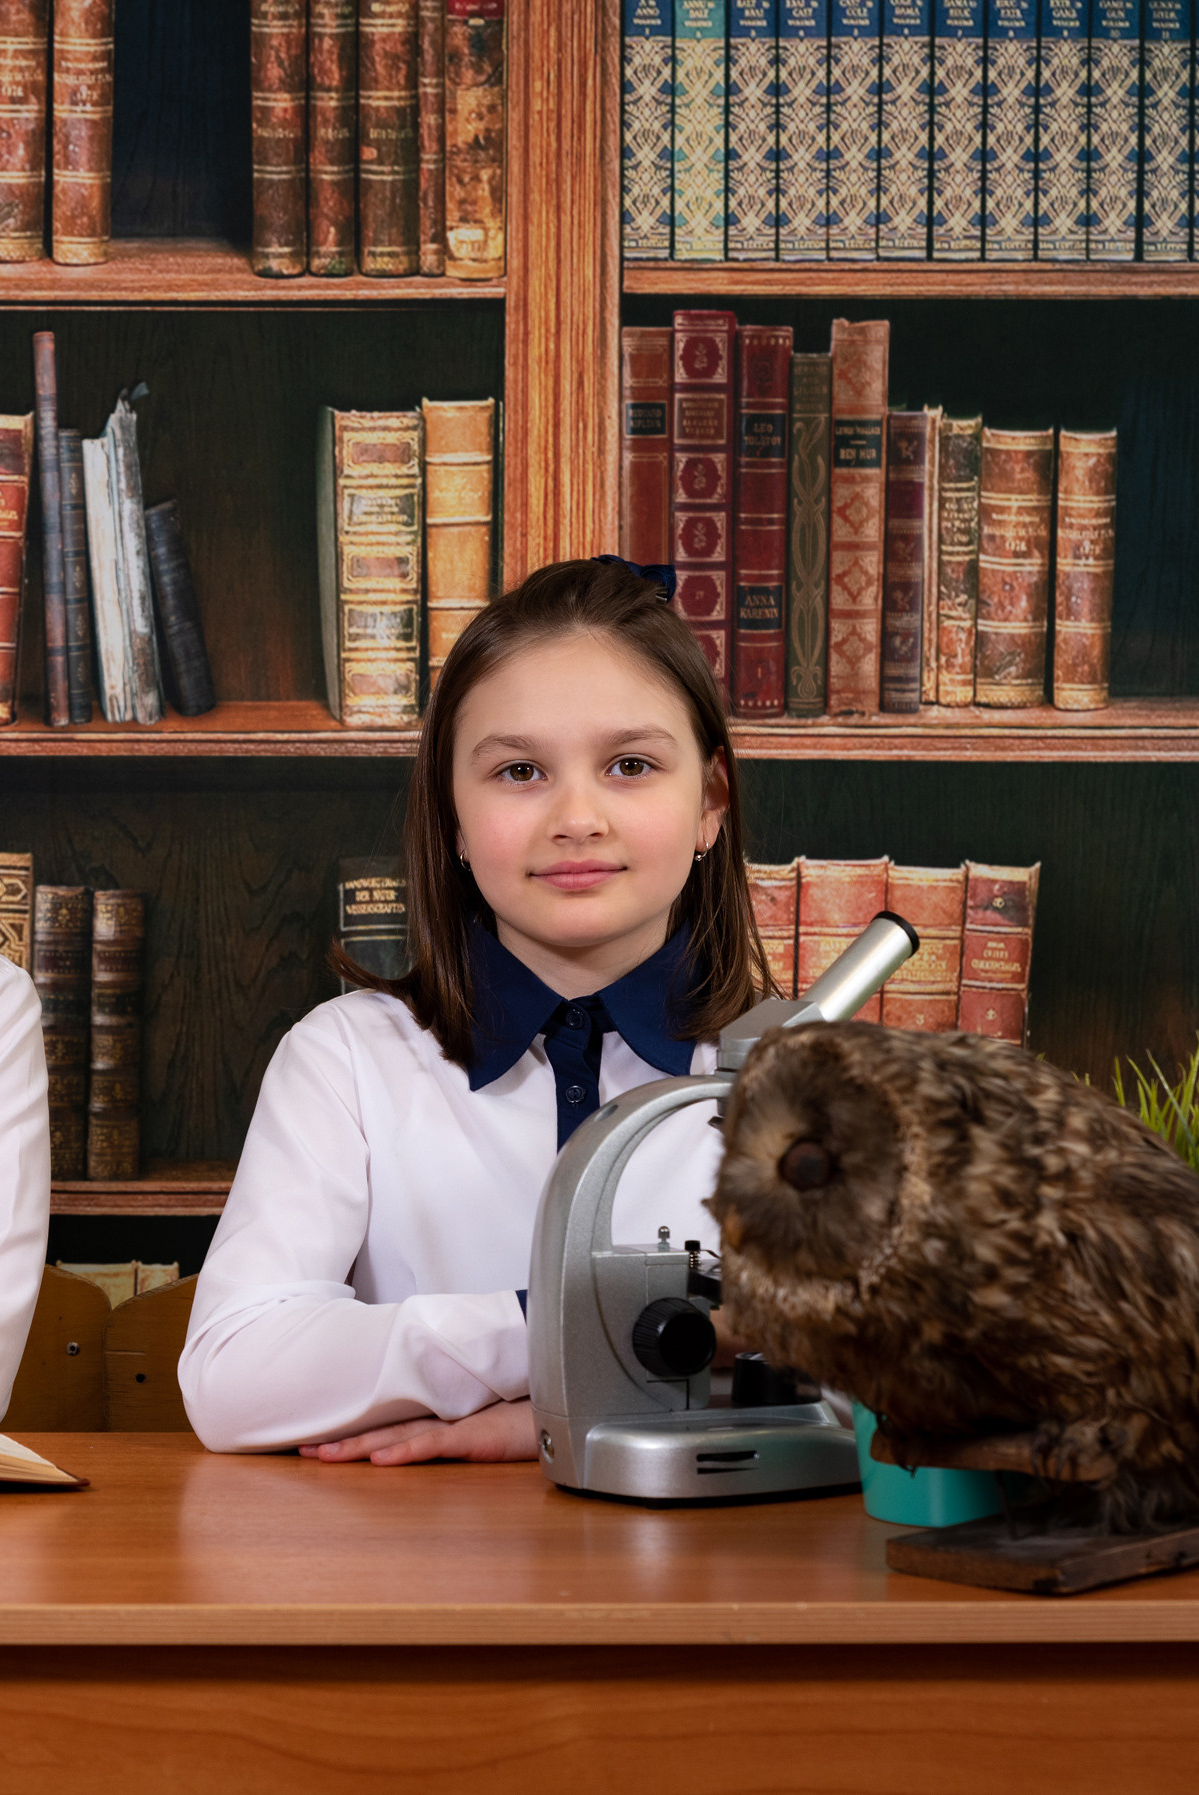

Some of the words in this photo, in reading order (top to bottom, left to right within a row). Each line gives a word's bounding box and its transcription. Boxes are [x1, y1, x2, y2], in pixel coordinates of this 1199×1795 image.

[1106, 10, 1125, 18] GUN
[753, 423, 773, 432] LEO
[743, 436, 782, 446] TOLSTOY
[840, 448, 857, 460] BEN
[859, 448, 877, 460] HUR
[745, 596, 775, 606] ANNA
[740, 608, 779, 619] KARENIN
